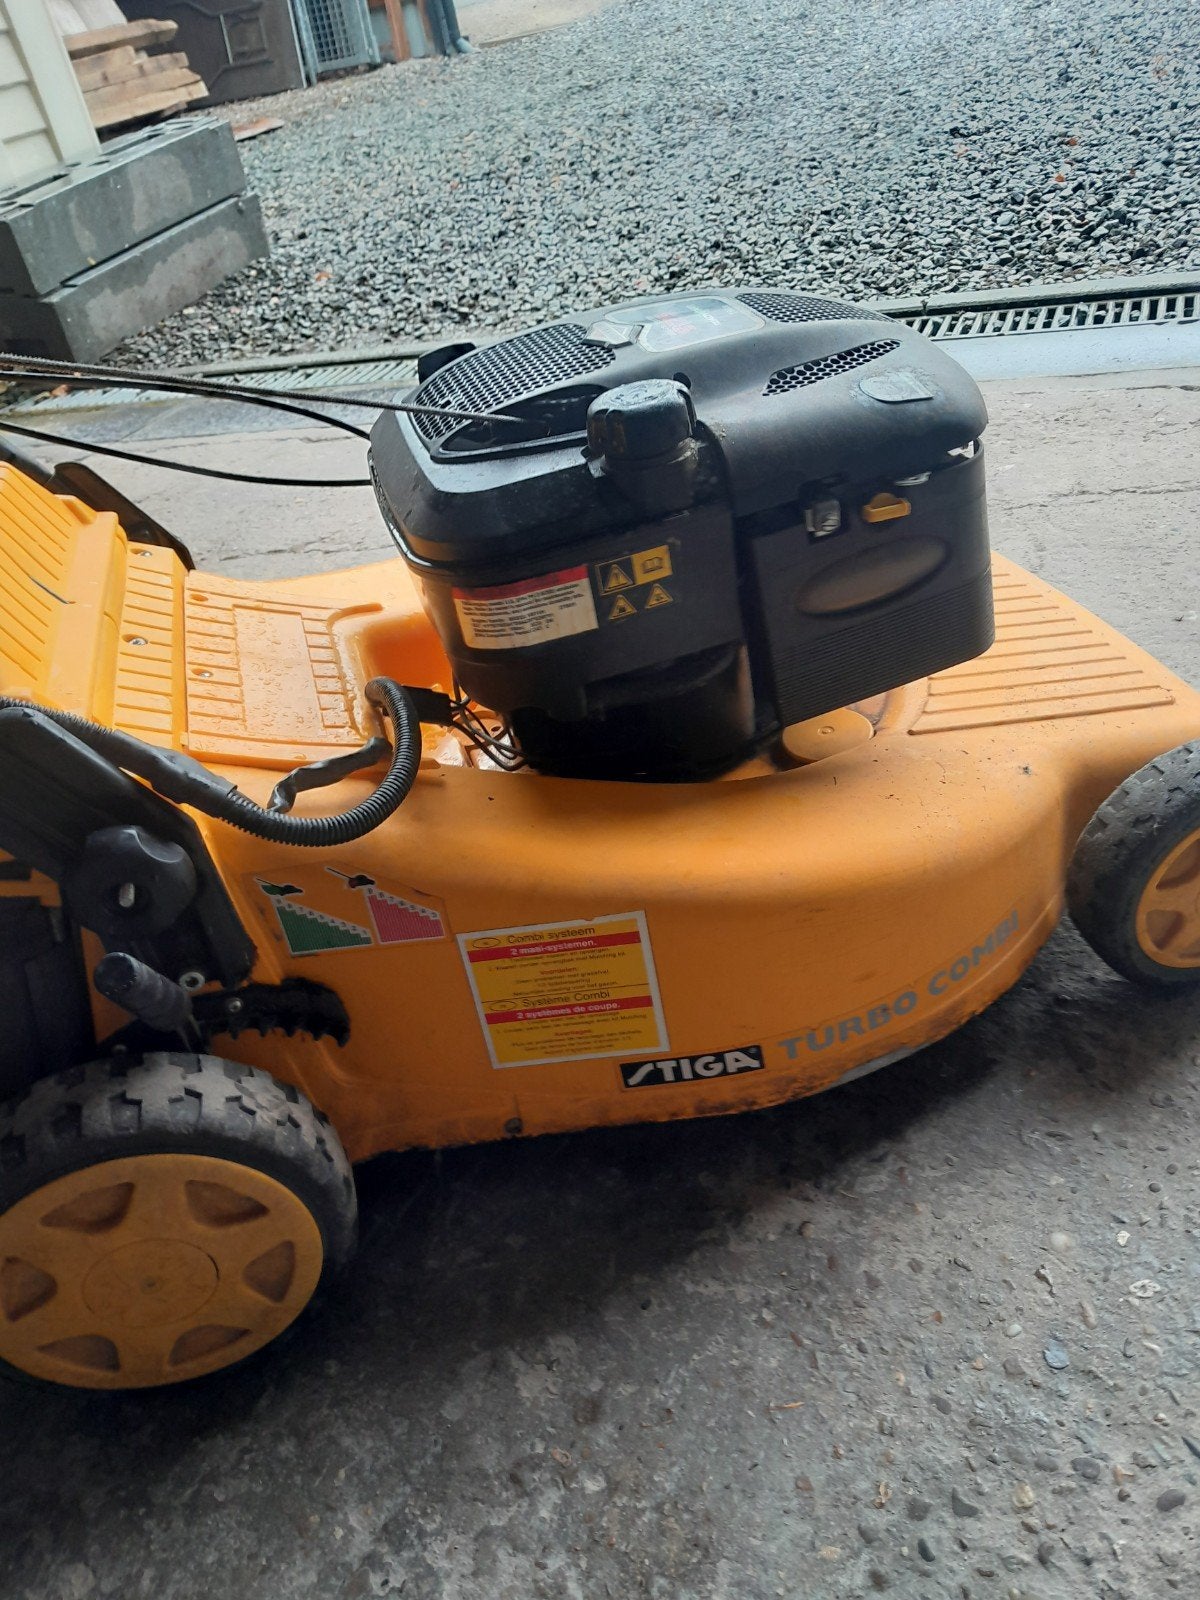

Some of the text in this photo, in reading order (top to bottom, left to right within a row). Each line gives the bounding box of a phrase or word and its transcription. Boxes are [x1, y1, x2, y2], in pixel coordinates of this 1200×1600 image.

[506, 926, 596, 945] Combi systeem
[510, 947, 519, 956] 2
[777, 909, 1021, 1061] TURBO COMBI
[573, 989, 611, 1001] Combi
[516, 1011, 524, 1020] 2
[574, 1005, 585, 1013] de
[588, 1001, 621, 1013] coupe.
[626, 1050, 762, 1088] STIGA
